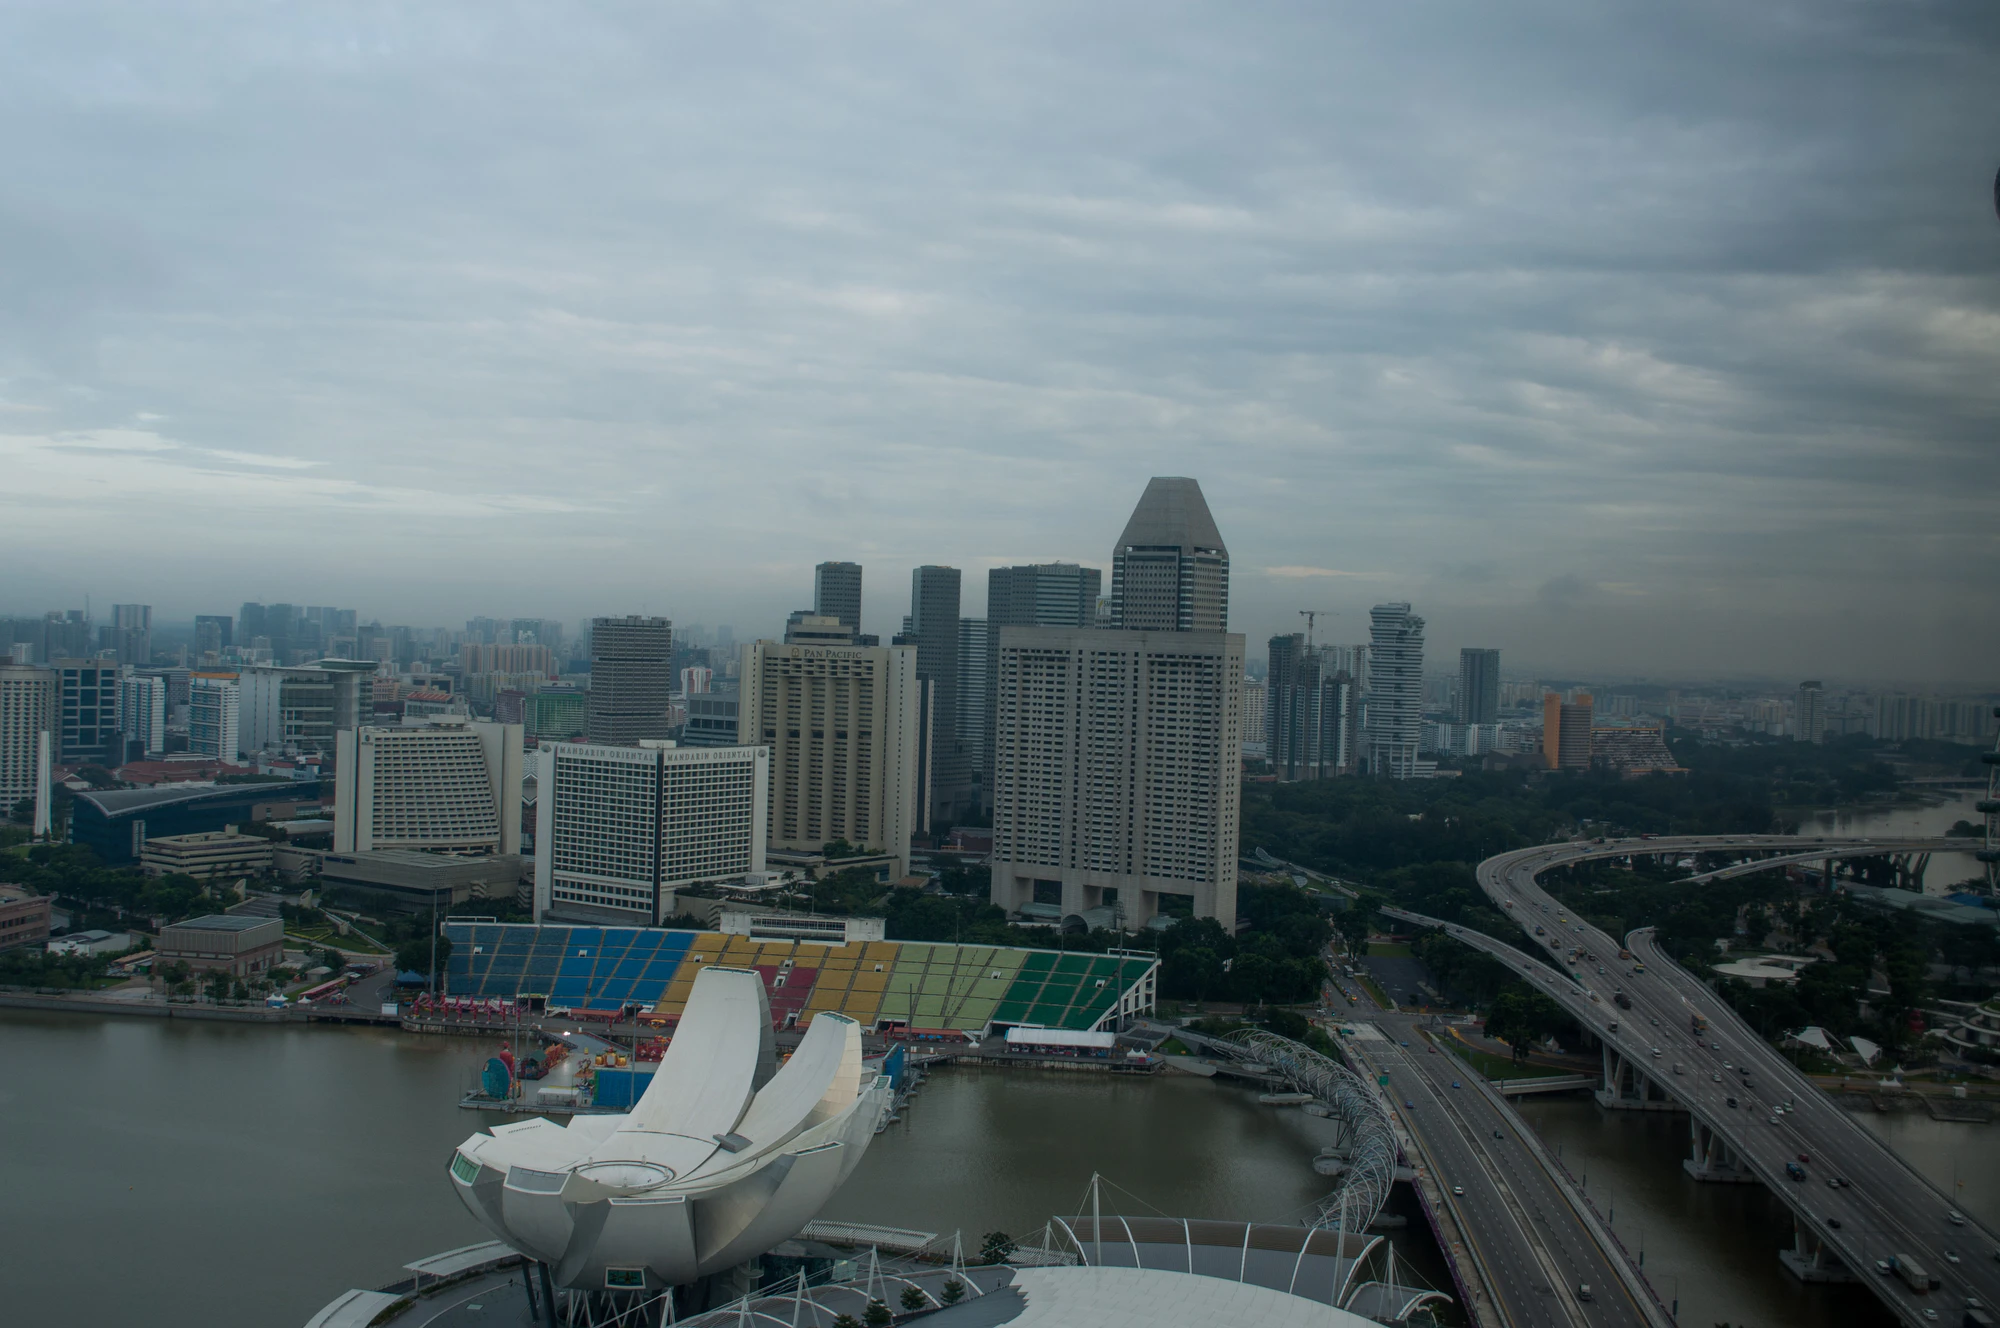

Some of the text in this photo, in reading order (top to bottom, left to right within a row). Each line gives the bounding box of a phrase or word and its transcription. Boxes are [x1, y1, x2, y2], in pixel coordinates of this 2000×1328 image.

[804, 649, 862, 659] PAN PACIFIC
[559, 746, 655, 761] MANDARIN ORIENTAL
[667, 750, 751, 762] MANDARIN ORIENTAL
